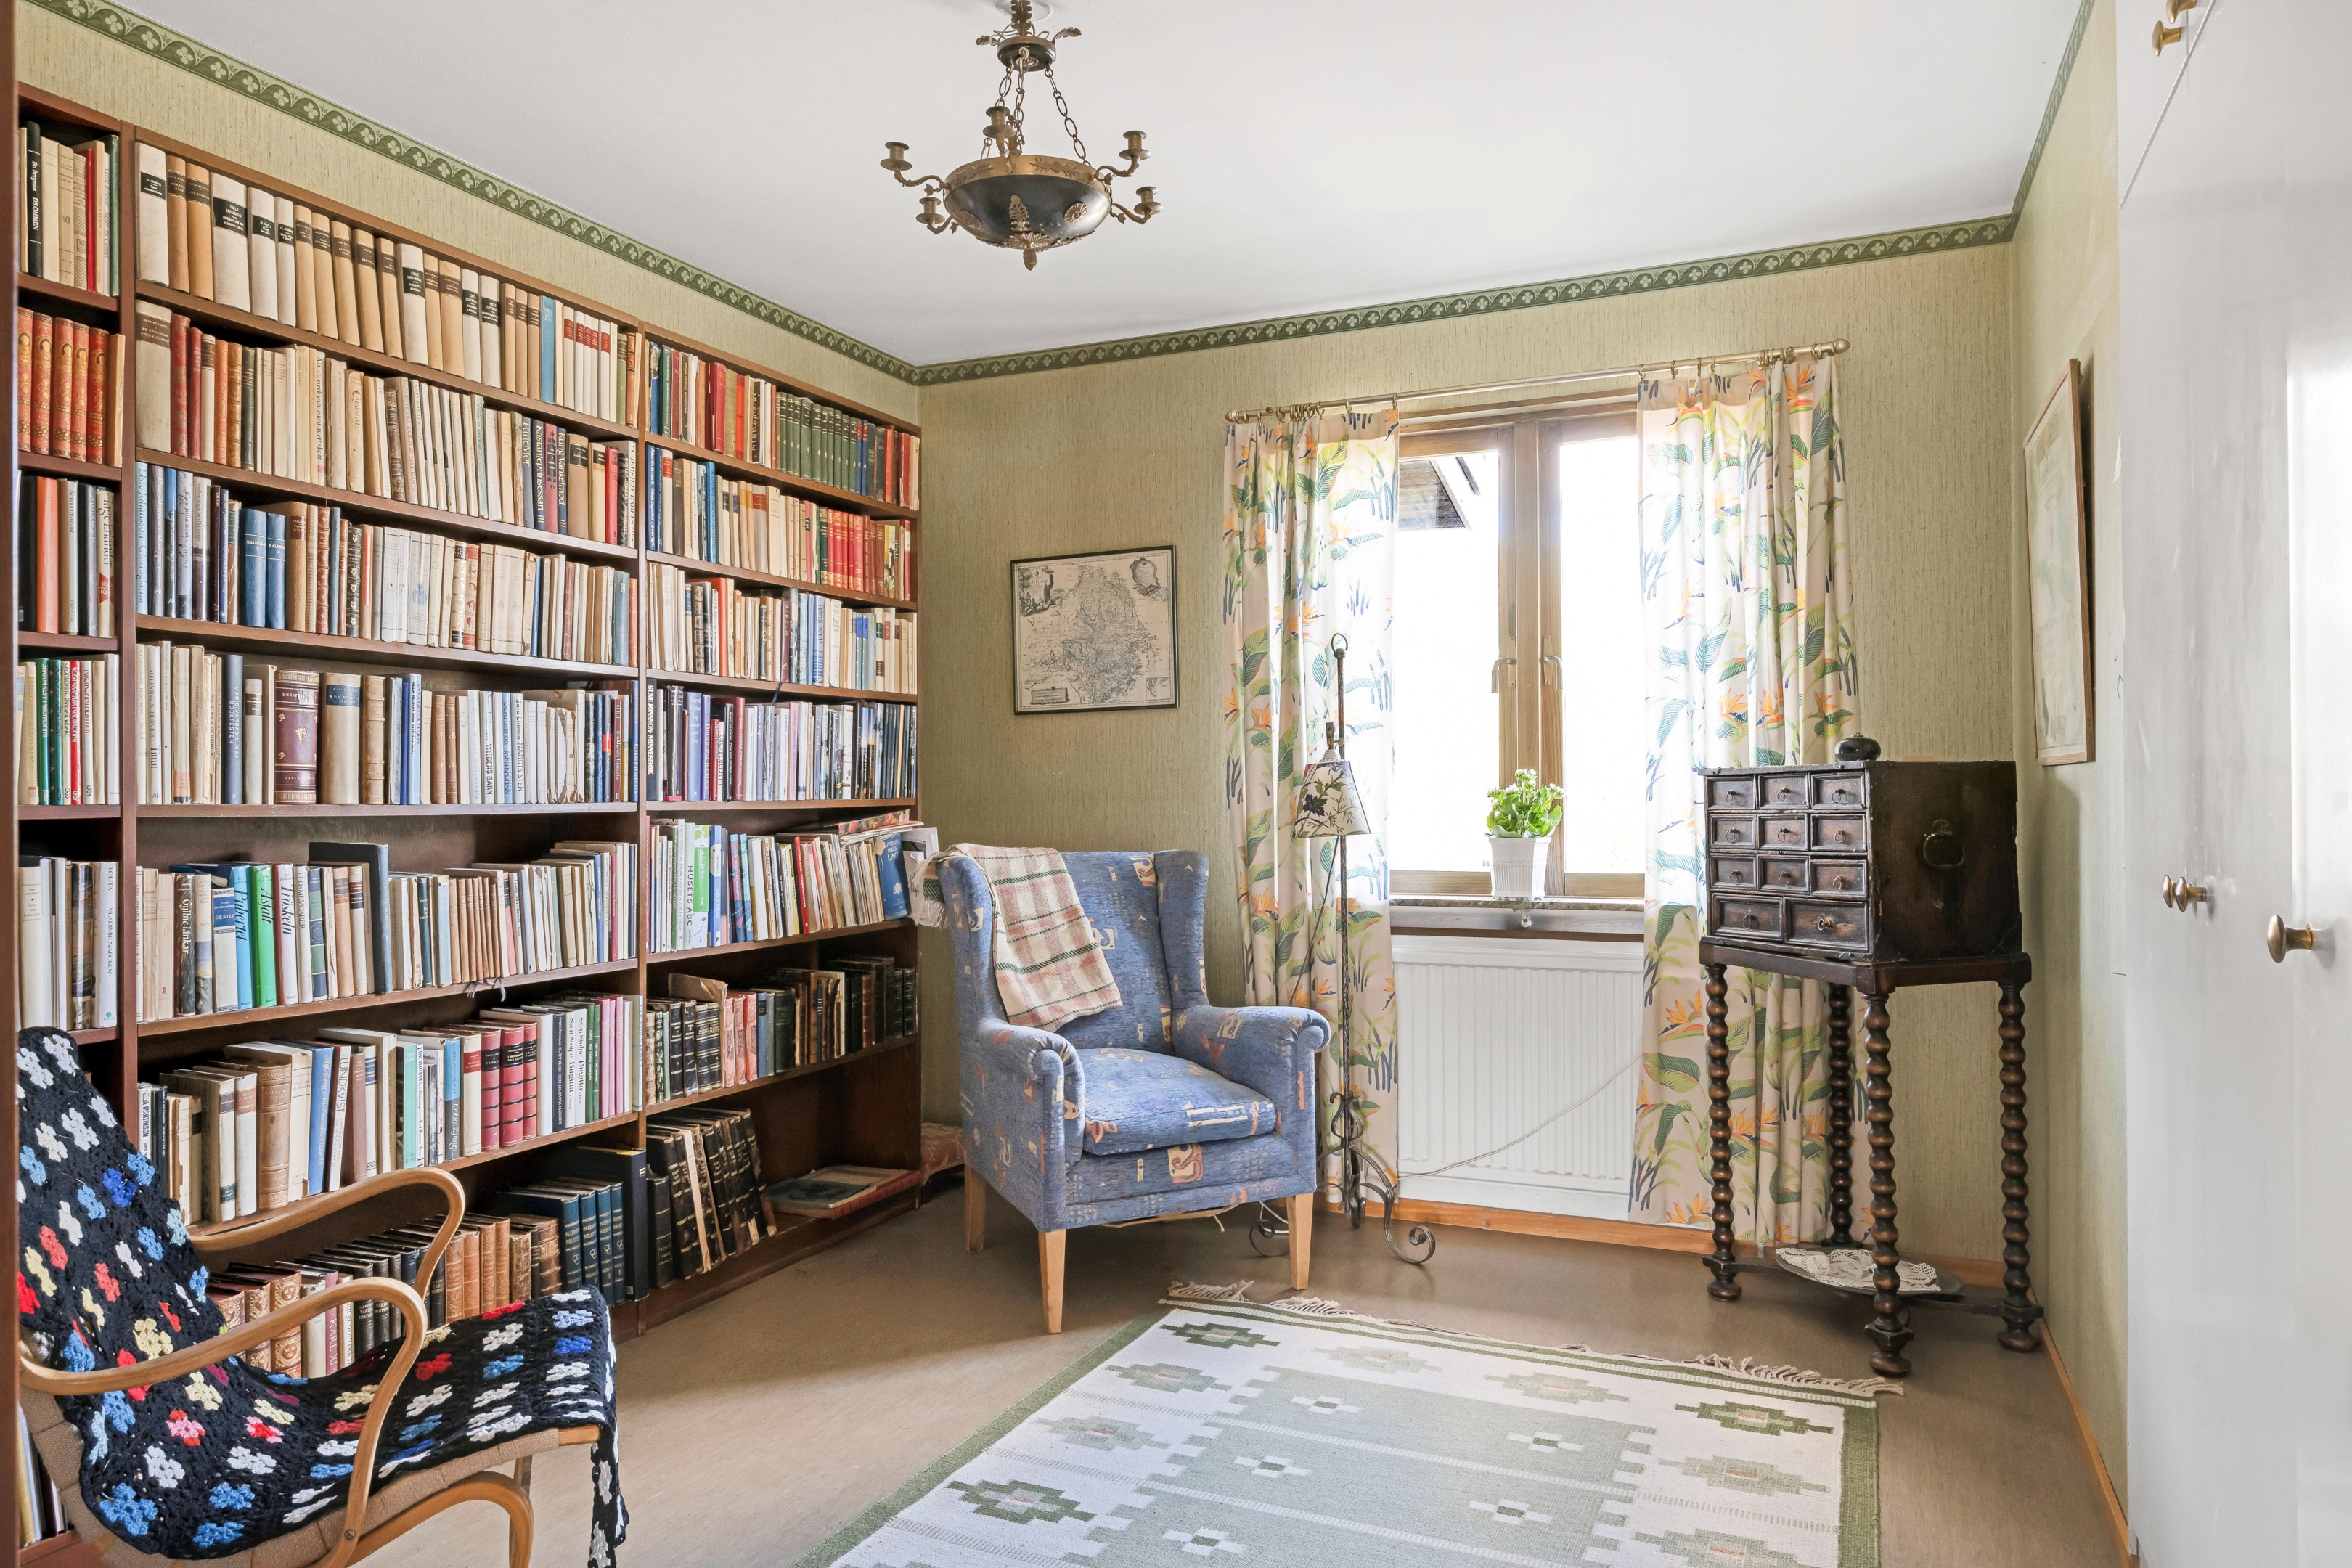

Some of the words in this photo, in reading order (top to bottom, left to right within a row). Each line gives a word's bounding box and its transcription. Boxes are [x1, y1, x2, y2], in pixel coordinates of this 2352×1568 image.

[556, 433, 566, 455] Kung
[536, 425, 544, 510] Kastanjeprinsessan
[556, 457, 566, 505] Vankelmod
[98, 499, 113, 522] Tage
[98, 523, 113, 568] Erlander
[234, 890, 248, 942] Pubertet
[258, 888, 274, 923] Asfalt
[281, 885, 294, 935] Tröskeln
[180, 926, 192, 954] länkar
[336, 1058, 349, 1113] LUNDKVIST
[328, 1320, 340, 1350] KARL
